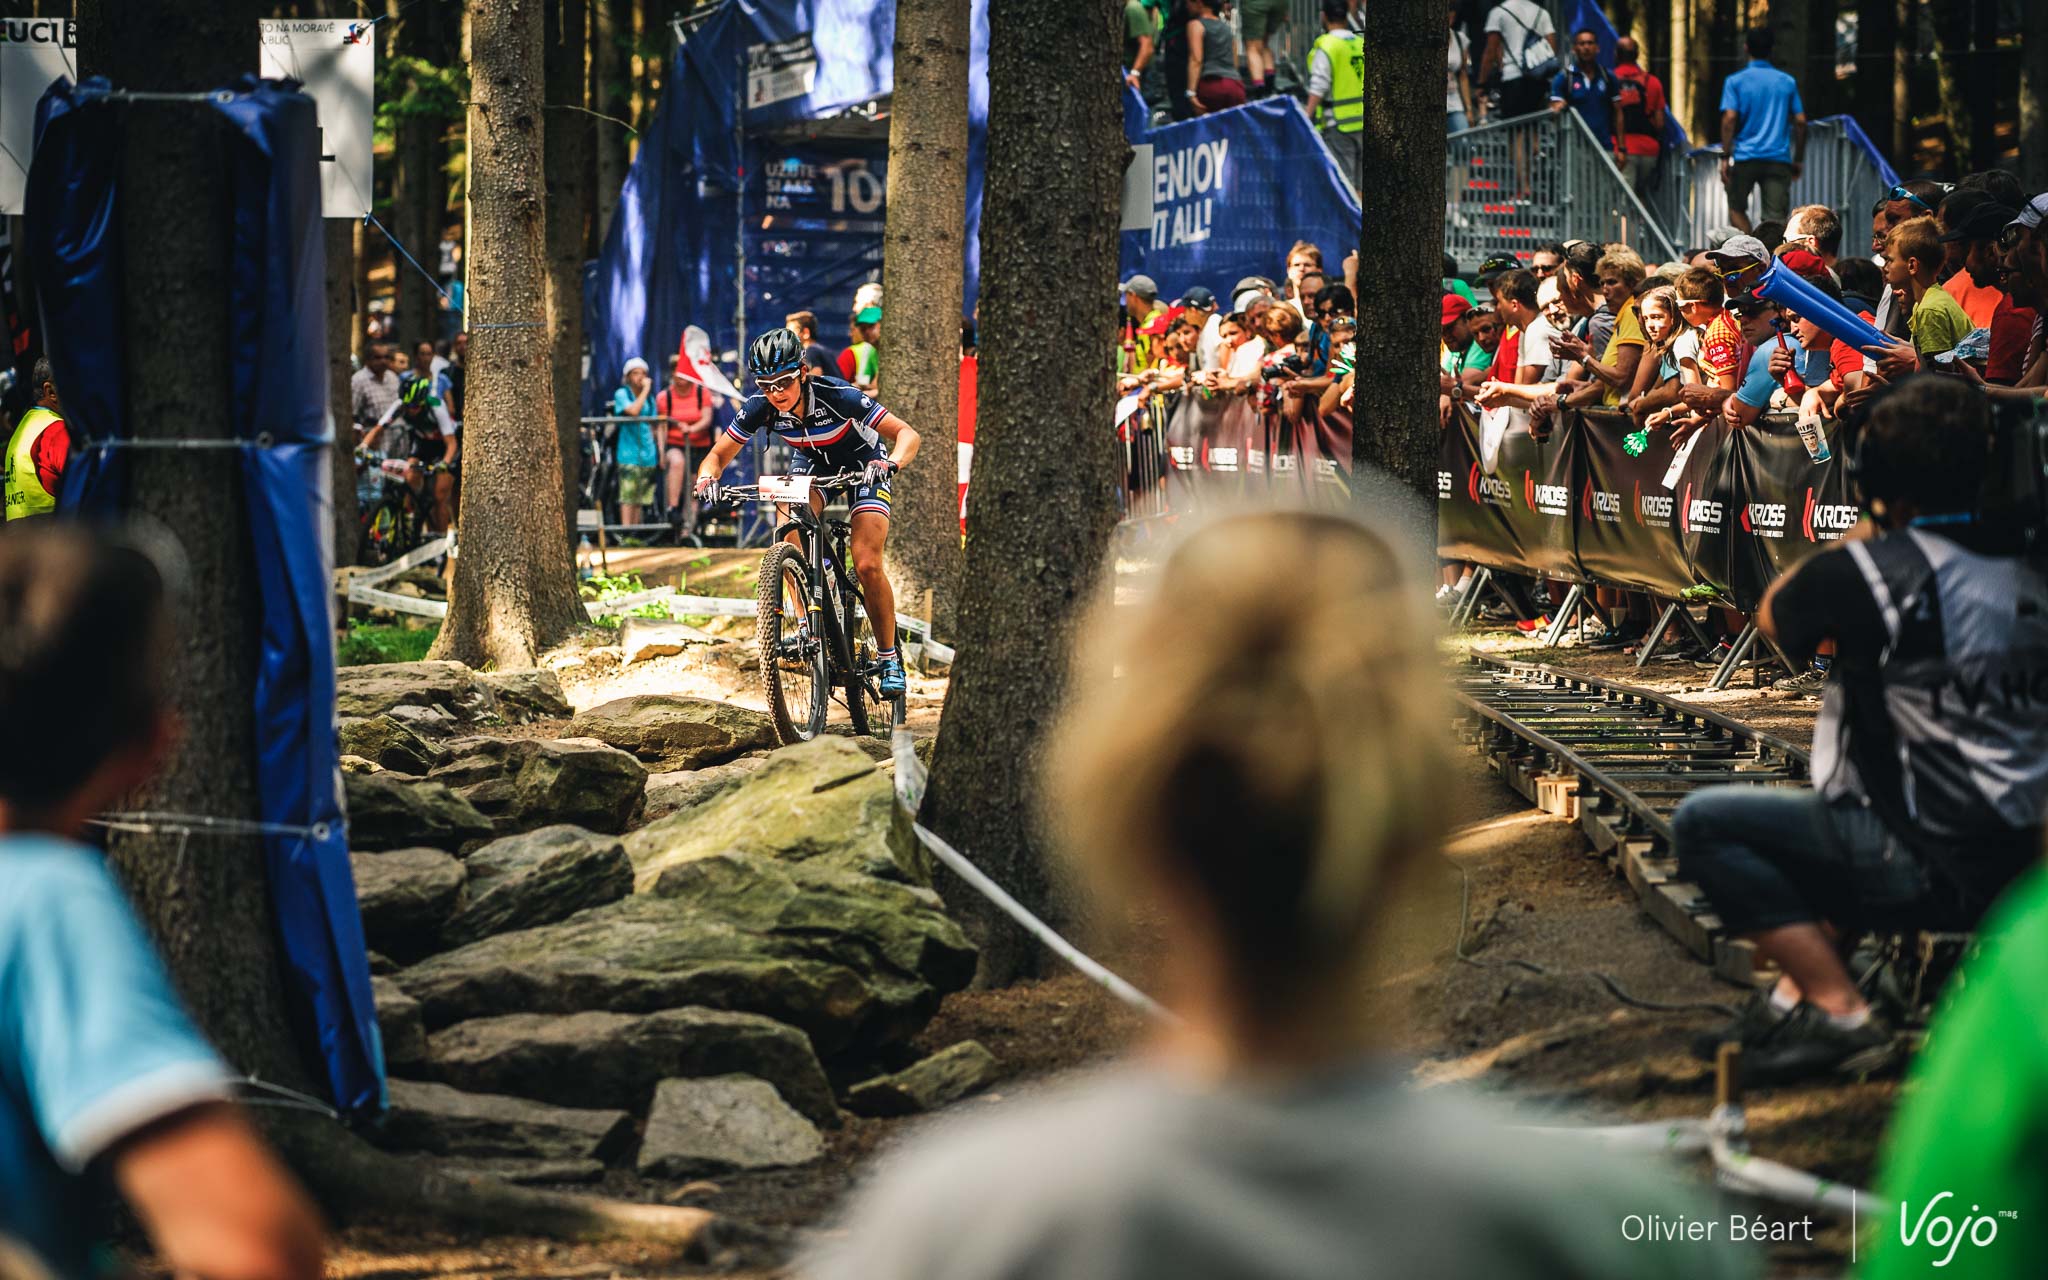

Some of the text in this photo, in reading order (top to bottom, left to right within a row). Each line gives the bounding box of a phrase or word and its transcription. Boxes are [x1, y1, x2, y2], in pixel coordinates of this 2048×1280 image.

[8, 21, 58, 44] UCI
[276, 23, 290, 33] NA
[1154, 138, 1229, 203] ENJOY
[1151, 198, 1212, 251] IT ALL!
[1479, 476, 1512, 499] KROSS
[1535, 484, 1568, 507] KROSS
[1592, 491, 1620, 513] KROSS
[1641, 495, 1674, 518] KROSS
[1748, 503, 1787, 527] KROSS
[1813, 504, 1859, 529] KROSS
